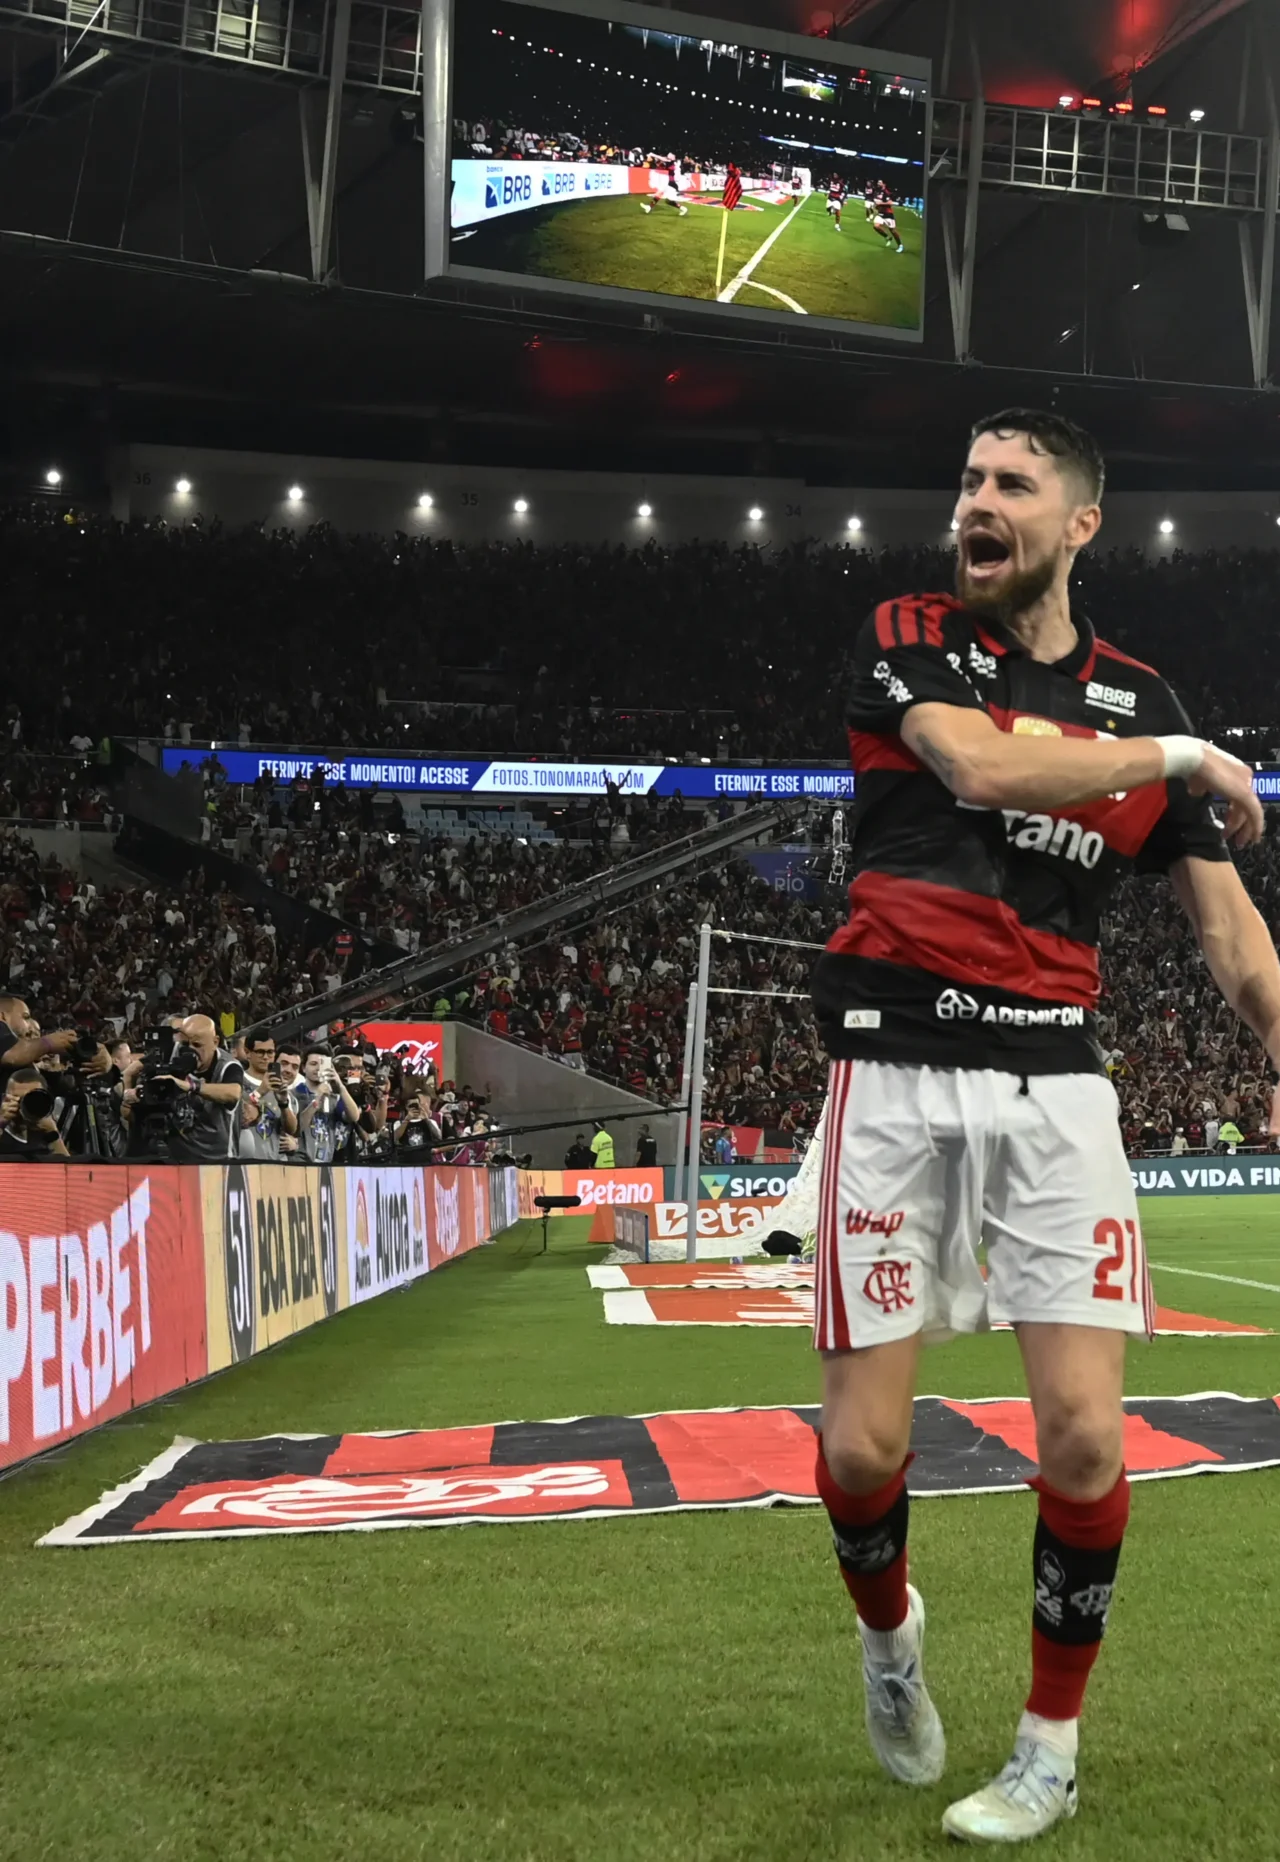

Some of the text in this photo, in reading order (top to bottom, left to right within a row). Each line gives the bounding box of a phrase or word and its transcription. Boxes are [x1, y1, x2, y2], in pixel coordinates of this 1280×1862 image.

[503, 175, 532, 205] BRB
[554, 173, 576, 194] BRB
[460, 492, 479, 507] 35
[785, 504, 803, 518] 34
[1103, 686, 1136, 708] BRB
[350, 764, 416, 784] MOMENTO!
[419, 767, 470, 785] ACESSE
[714, 774, 855, 793] ETERNIZE ESSE MOMENT
[981, 1004, 1084, 1027] ADEMICON
[1181, 1169, 1245, 1187] VIDA
[576, 1179, 653, 1207] Betano
[376, 1178, 410, 1284] Aurora
[655, 1202, 774, 1237] Beta
[321, 1186, 335, 1294] 51
[229, 1190, 250, 1332] 51
[256, 1196, 289, 1318] BOA
[1092, 1218, 1138, 1303] 21
